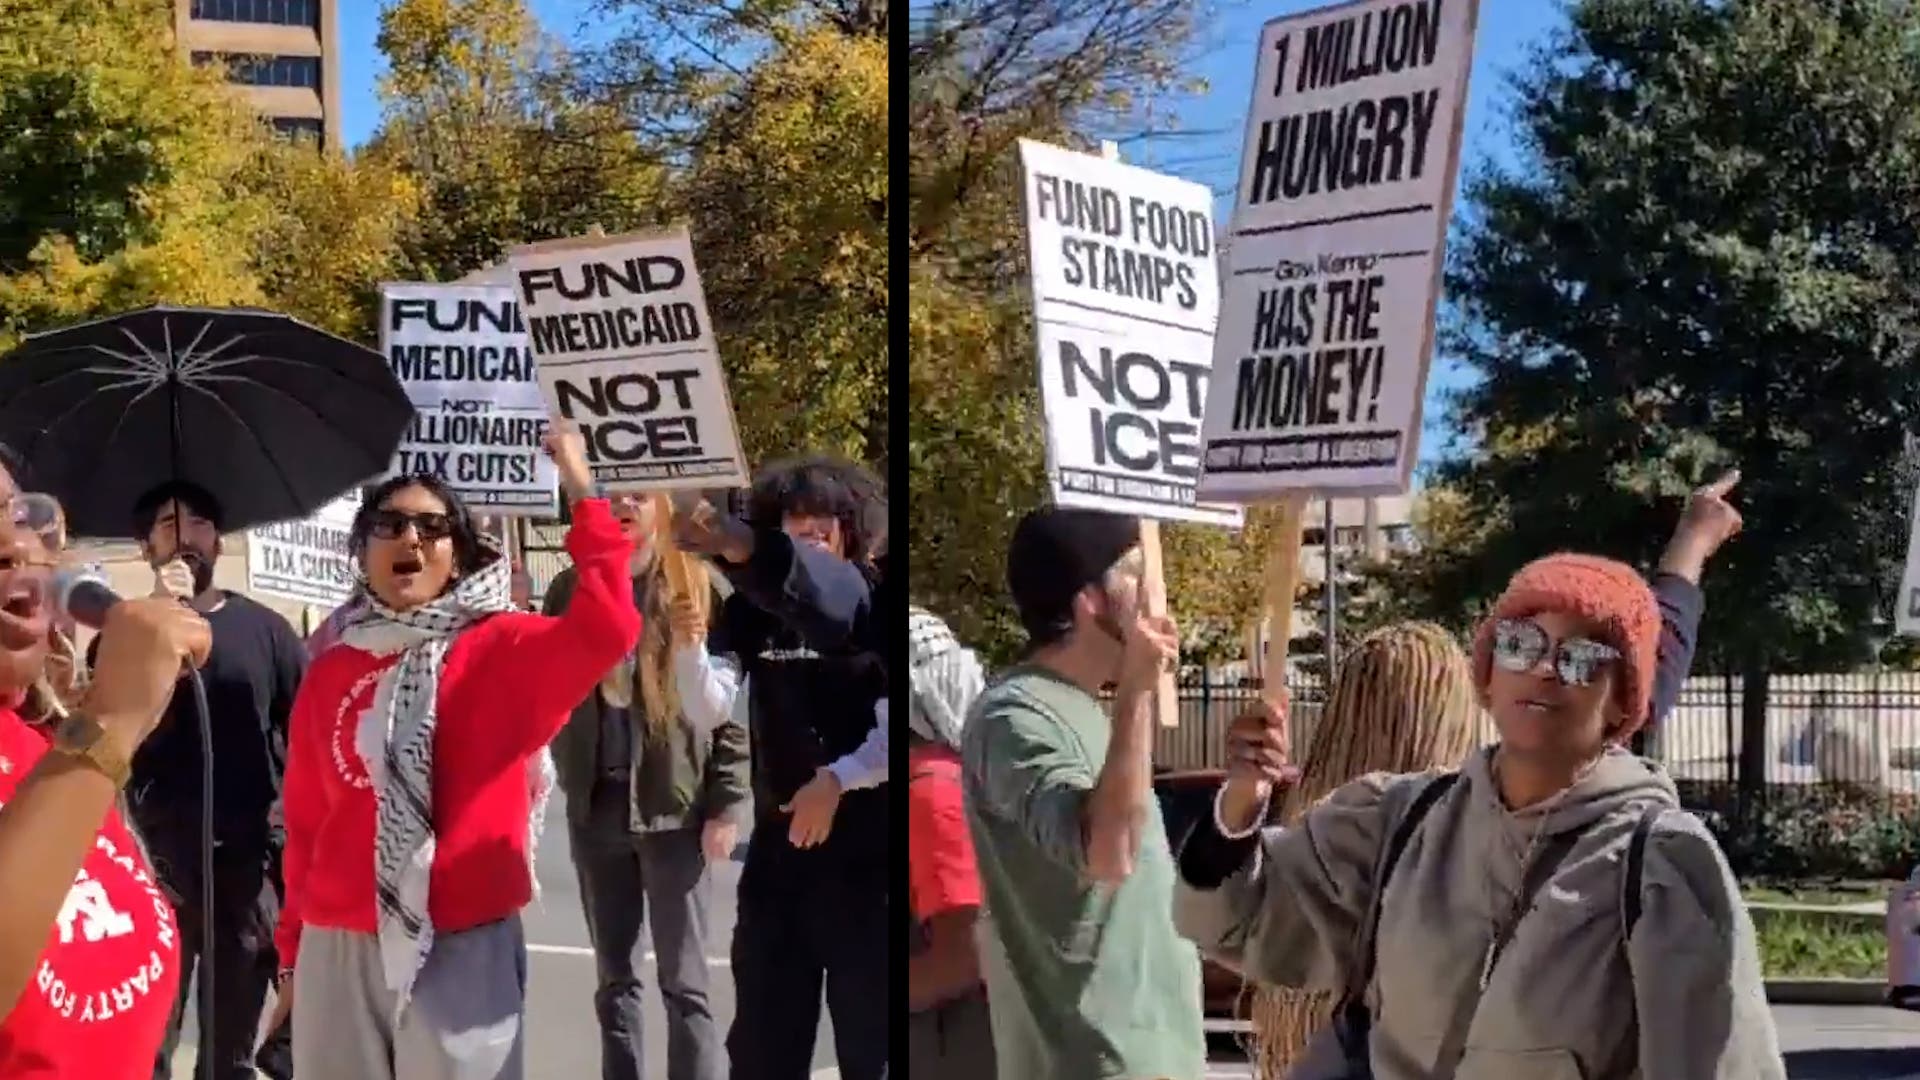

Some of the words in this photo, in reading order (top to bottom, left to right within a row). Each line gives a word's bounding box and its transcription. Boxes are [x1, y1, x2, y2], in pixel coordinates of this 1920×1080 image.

[1273, 33, 1291, 97] 1
[1296, 0, 1441, 93] MILLION
[1250, 88, 1440, 204] HUNGRY
[1036, 173, 1122, 239] FUND
[1128, 196, 1210, 258] FOOD
[519, 255, 685, 305] FUND
[1061, 234, 1197, 311] STAMPS
[1317, 253, 1378, 276] Kemp
[529, 302, 702, 354] MEDICAID
[1253, 283, 1316, 352] HAS
[1323, 275, 1385, 343] THE
[391, 344, 537, 382] MEDICAI
[1058, 340, 1211, 418] NOT
[1232, 346, 1386, 431] MONEY!
[441, 399, 493, 414] NOT
[554, 369, 701, 419] NOT
[405, 414, 551, 447] ILLIONAIRE
[579, 417, 704, 461] ICE!
[1090, 406, 1200, 477] ICE
[400, 451, 450, 481] TAX
[456, 452, 536, 483] CUTS!
[262, 544, 296, 577] TAX
[37, 959, 77, 1018] FOR
[79, 950, 163, 1023] PARTY
